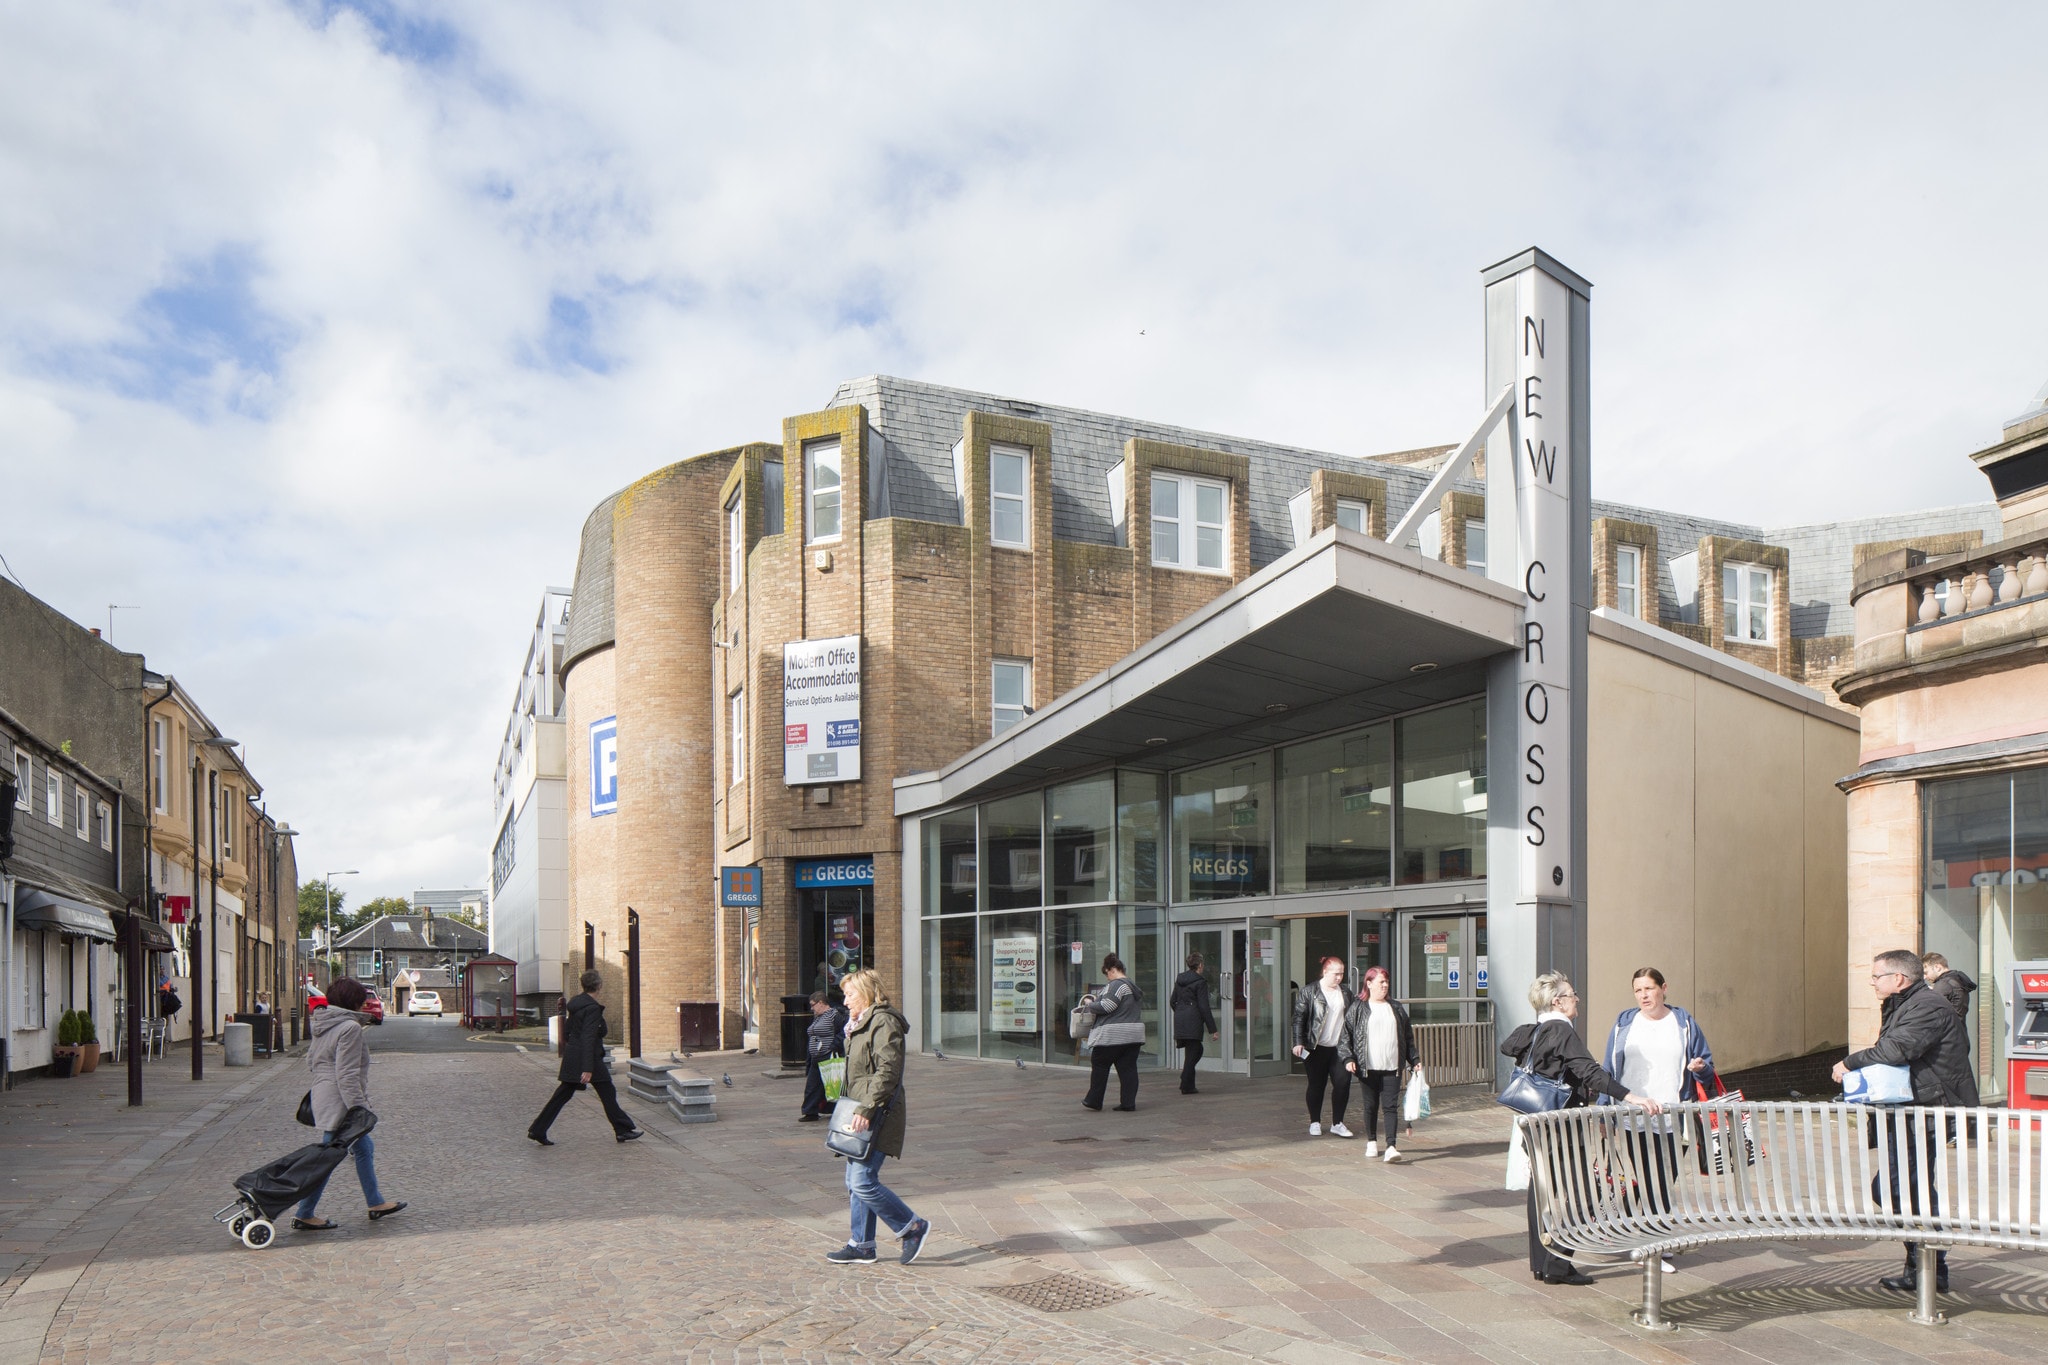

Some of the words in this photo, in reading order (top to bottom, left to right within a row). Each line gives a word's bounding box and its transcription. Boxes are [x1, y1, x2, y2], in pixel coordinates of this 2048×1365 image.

[1524, 314, 1557, 485] NEW
[789, 654, 825, 670] Modern
[828, 648, 856, 666] Office
[785, 670, 860, 690] Accommodation
[785, 696, 809, 707] Serviced
[811, 694, 833, 708] Options
[834, 692, 859, 702] Available
[1524, 560, 1549, 847] CROSS
[816, 864, 874, 881] GREGGS
[1189, 858, 1249, 876] REGGS
[727, 893, 758, 902] GREGGS
[163, 895, 191, 924] T
[1015, 957, 1035, 968] Argos
